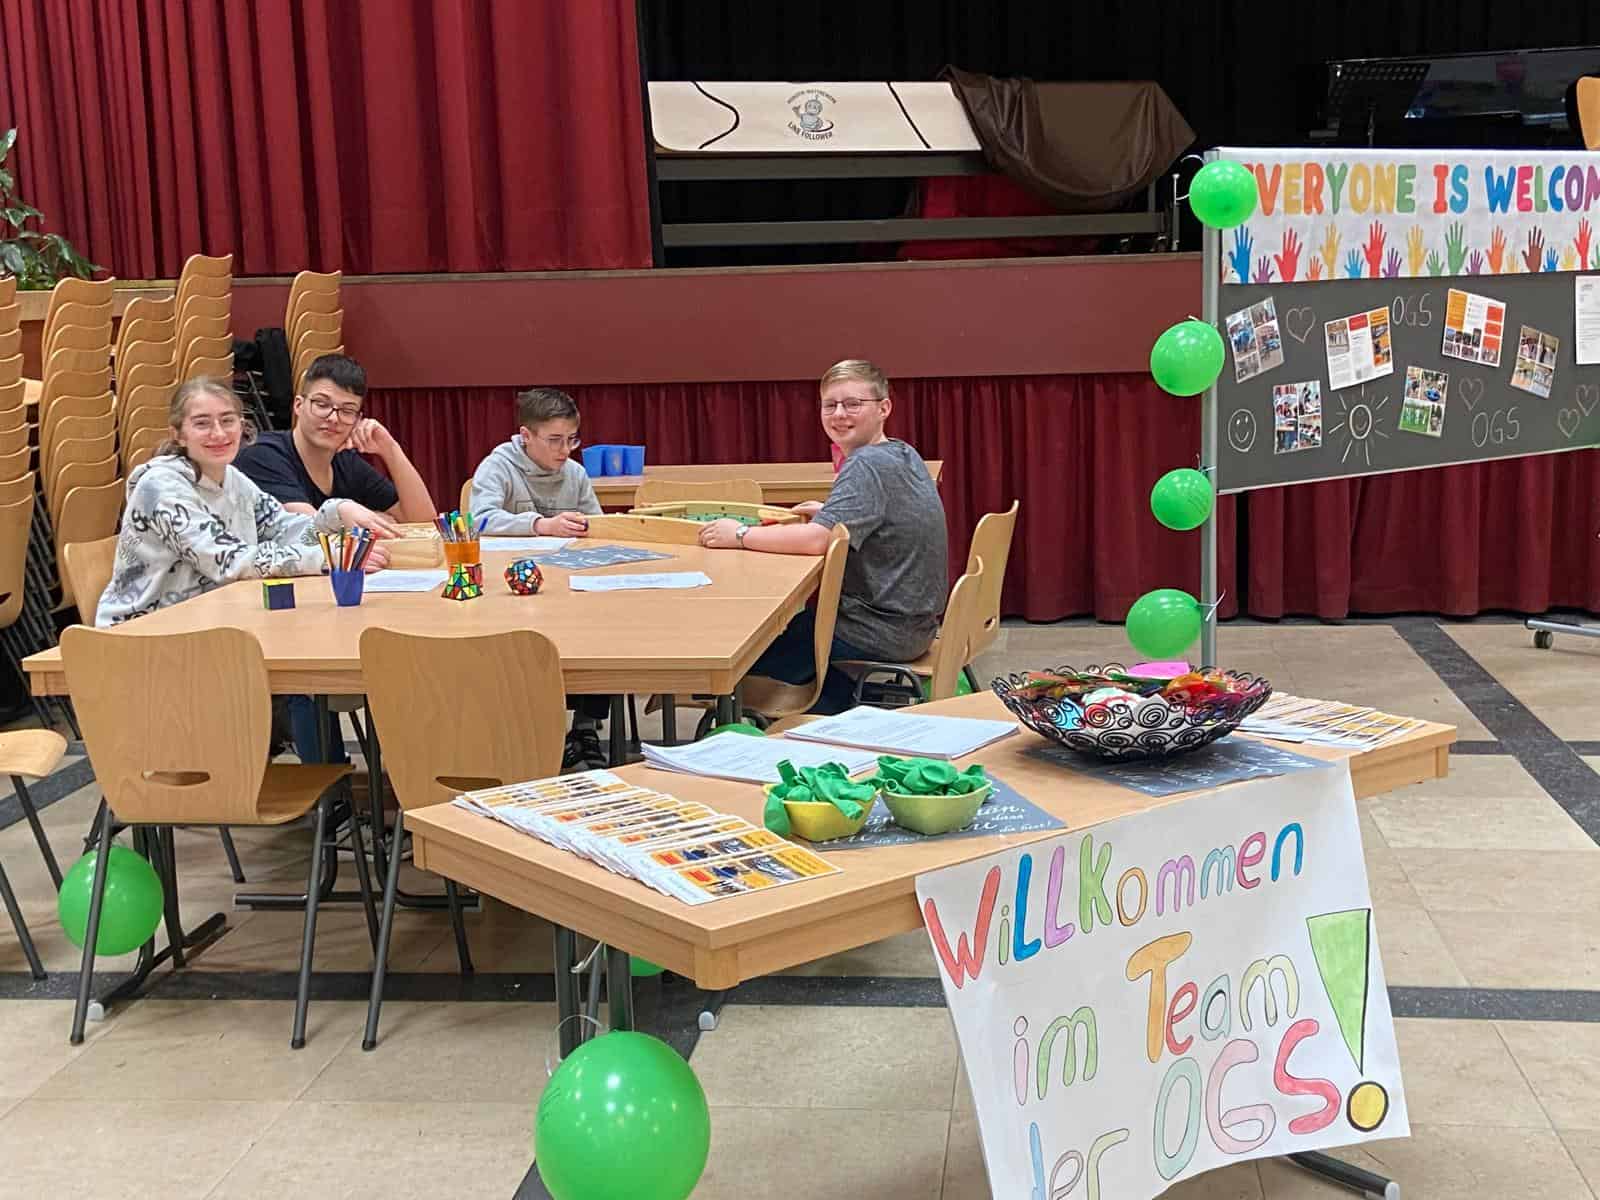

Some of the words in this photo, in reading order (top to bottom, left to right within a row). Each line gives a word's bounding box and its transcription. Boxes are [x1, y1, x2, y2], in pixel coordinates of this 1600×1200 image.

[1242, 162, 1416, 216] VERYONE
[1433, 164, 1469, 213] IS
[1392, 292, 1432, 327] OGS
[1471, 406, 1520, 448] OGS
[1013, 1006, 1098, 1107] im
[1125, 931, 1301, 1064] Team
